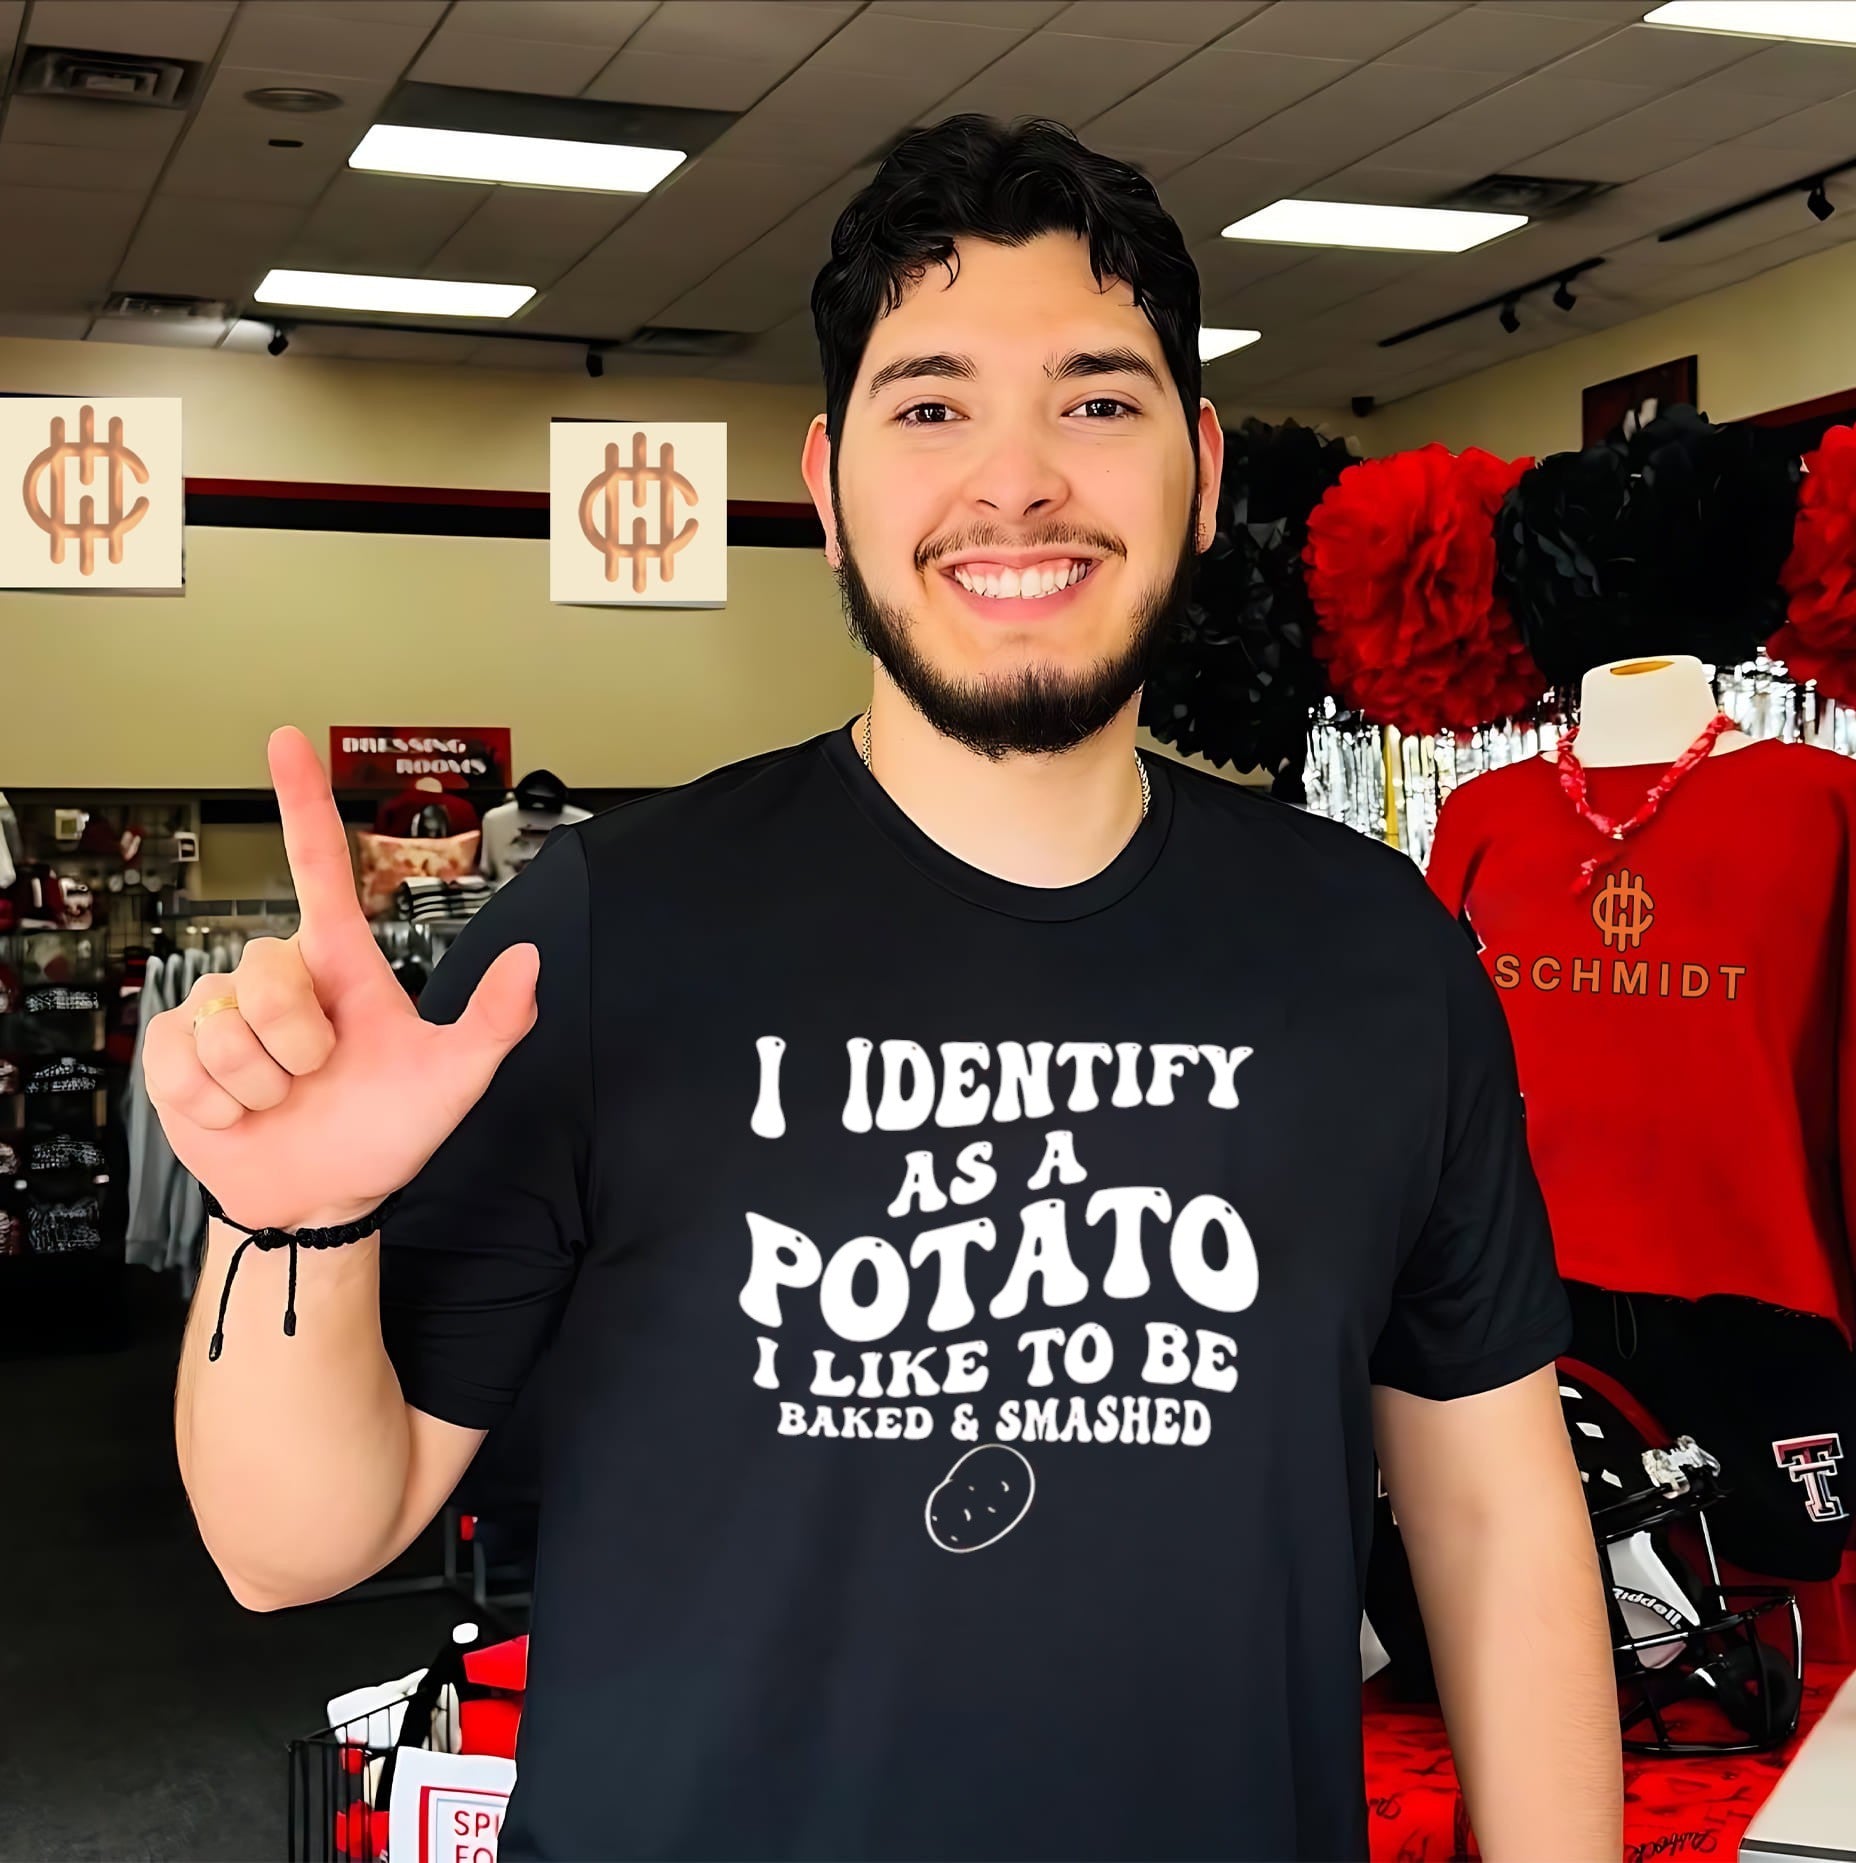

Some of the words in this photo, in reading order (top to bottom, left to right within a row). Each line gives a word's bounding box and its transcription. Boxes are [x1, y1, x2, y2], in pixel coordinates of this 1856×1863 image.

[342, 737, 467, 753] DRESSING
[396, 758, 487, 775] ROOMS
[1494, 954, 1746, 1000] SCHMIDT
[750, 1036, 787, 1139] I
[841, 1037, 1254, 1134] IDENTIFY
[887, 1140, 998, 1218] AS
[1027, 1129, 1088, 1191] A
[738, 1186, 1260, 1343] POTATO
[753, 1336, 780, 1390] I
[809, 1340, 990, 1399] LIKE
[1017, 1321, 1114, 1388] TO
[1141, 1321, 1239, 1393] BE
[776, 1401, 934, 1440] BAKED
[950, 1402, 979, 1442] &
[995, 1394, 1212, 1447] SMASHED
